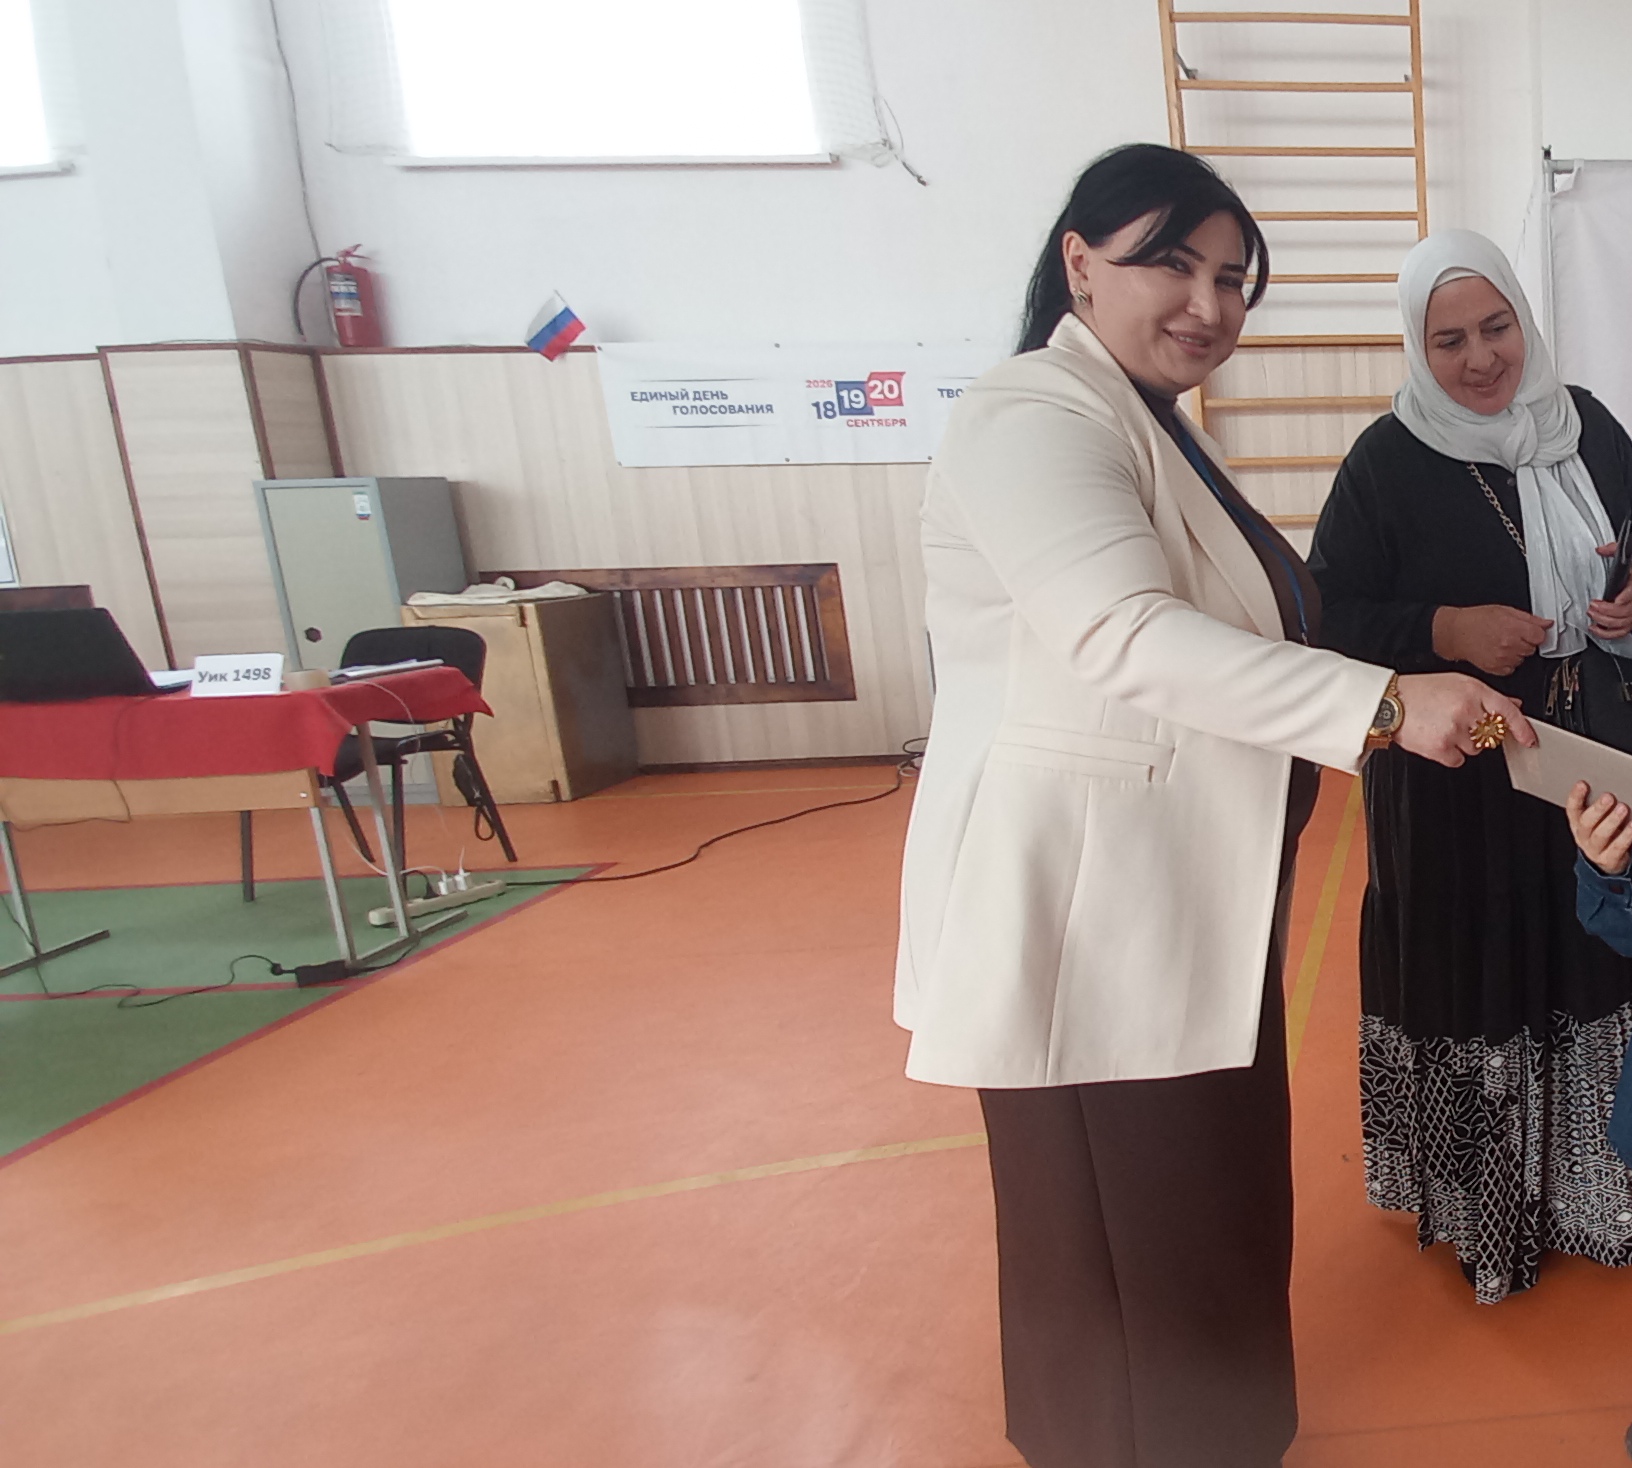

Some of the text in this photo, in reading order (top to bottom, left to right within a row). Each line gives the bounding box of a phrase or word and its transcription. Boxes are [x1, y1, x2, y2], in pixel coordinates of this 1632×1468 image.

[805, 379, 834, 388] 2026
[630, 388, 729, 402] ЕДИНЫЙ ДЕНЬ
[937, 388, 965, 399] ТВО
[811, 379, 900, 420] 18 19 20
[672, 404, 775, 415] ГОЛОСОВАНИЯ
[846, 418, 908, 428] СЕНТЯБРЯ
[198, 667, 272, 683] Уик 1498
